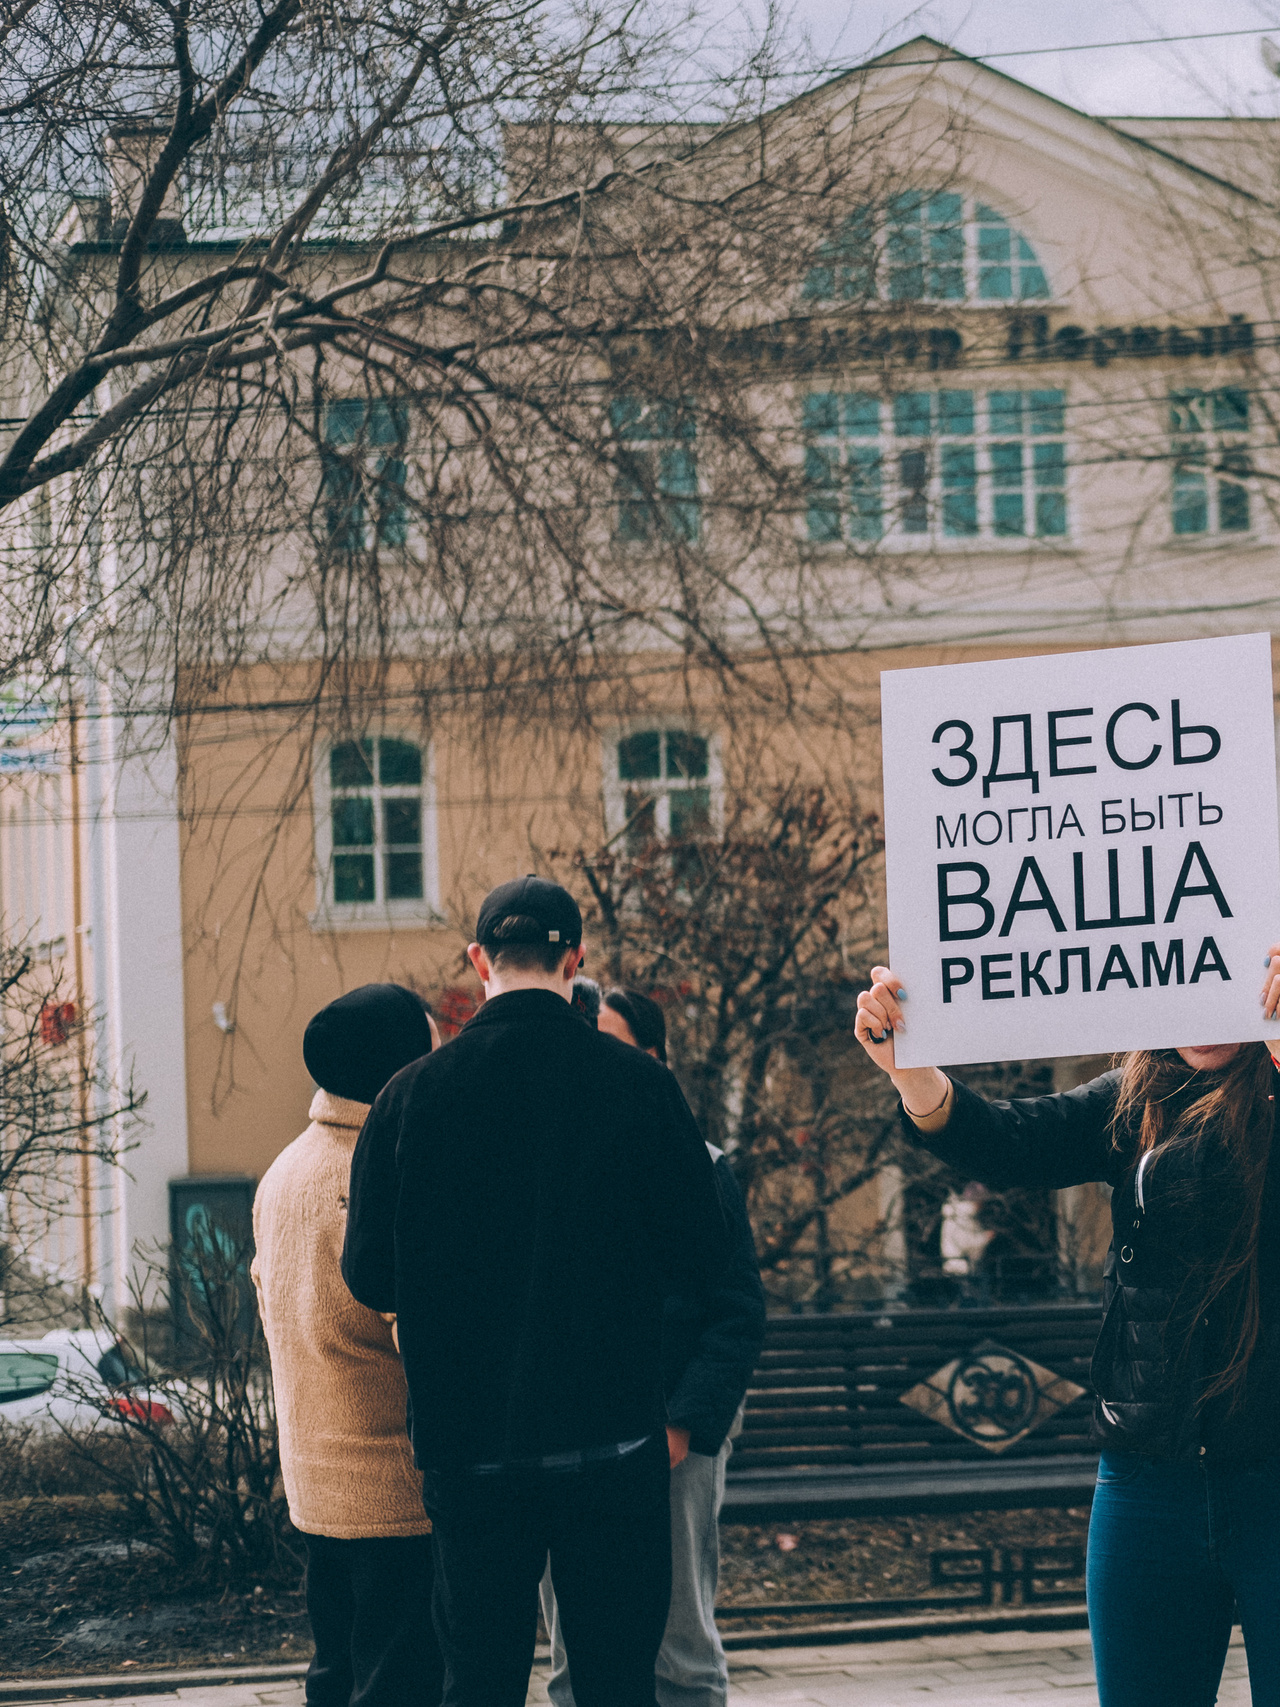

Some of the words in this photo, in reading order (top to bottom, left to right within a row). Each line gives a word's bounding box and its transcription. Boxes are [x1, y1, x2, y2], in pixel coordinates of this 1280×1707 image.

[931, 698, 1222, 799] ЗДЕСЬ
[935, 803, 1086, 850] МОГЛА
[1101, 791, 1224, 835] БЫТЬ
[936, 840, 1234, 943] ВАША
[940, 935, 1233, 1004] РЕКЛАМА
